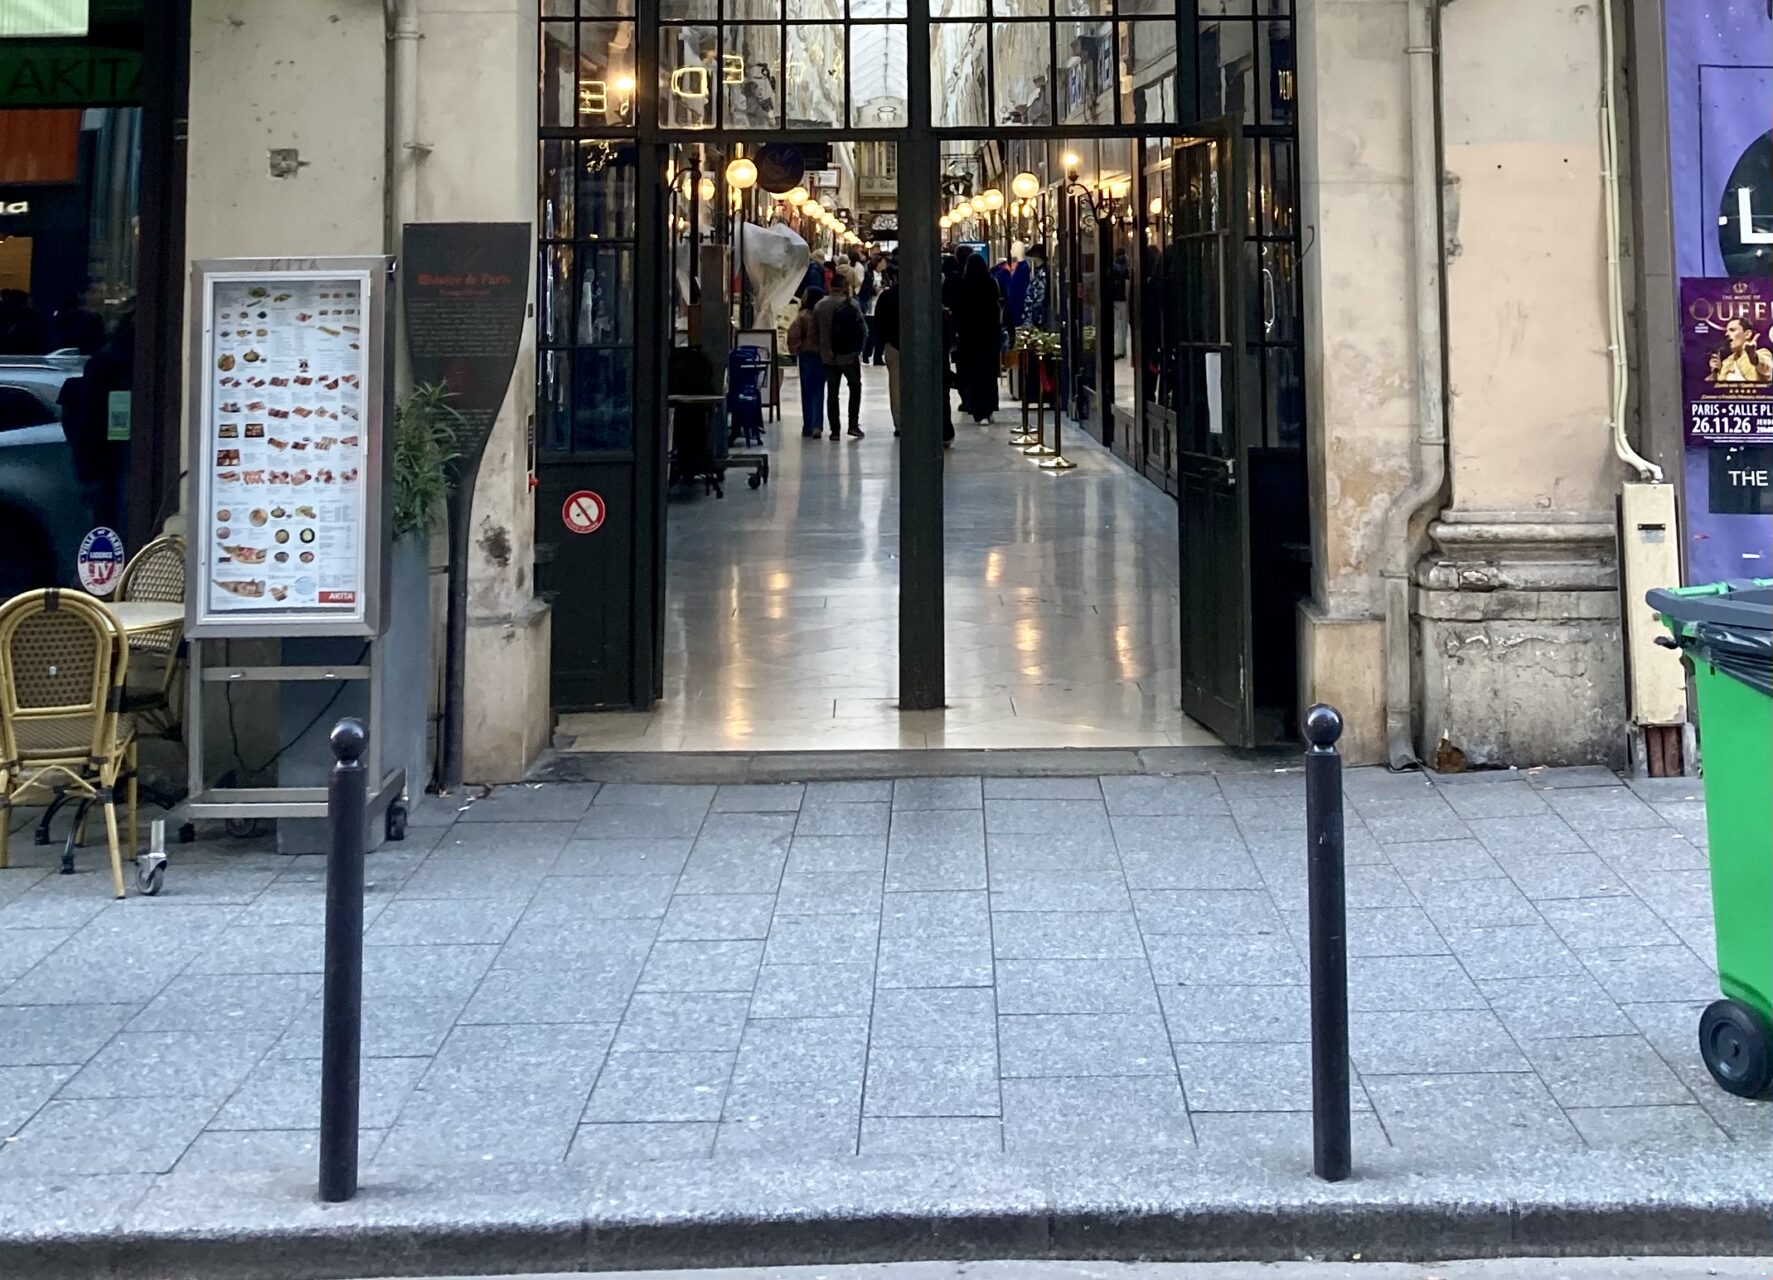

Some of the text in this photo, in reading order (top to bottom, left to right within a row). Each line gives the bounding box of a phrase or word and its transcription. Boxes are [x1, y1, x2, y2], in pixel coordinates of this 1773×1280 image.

[1689, 298, 1773, 331] QUEE
[1691, 404, 1720, 416] PARIS
[1728, 404, 1758, 416] SALLE
[1691, 417, 1752, 434] 26.11.26
[1728, 470, 1769, 487] THE
